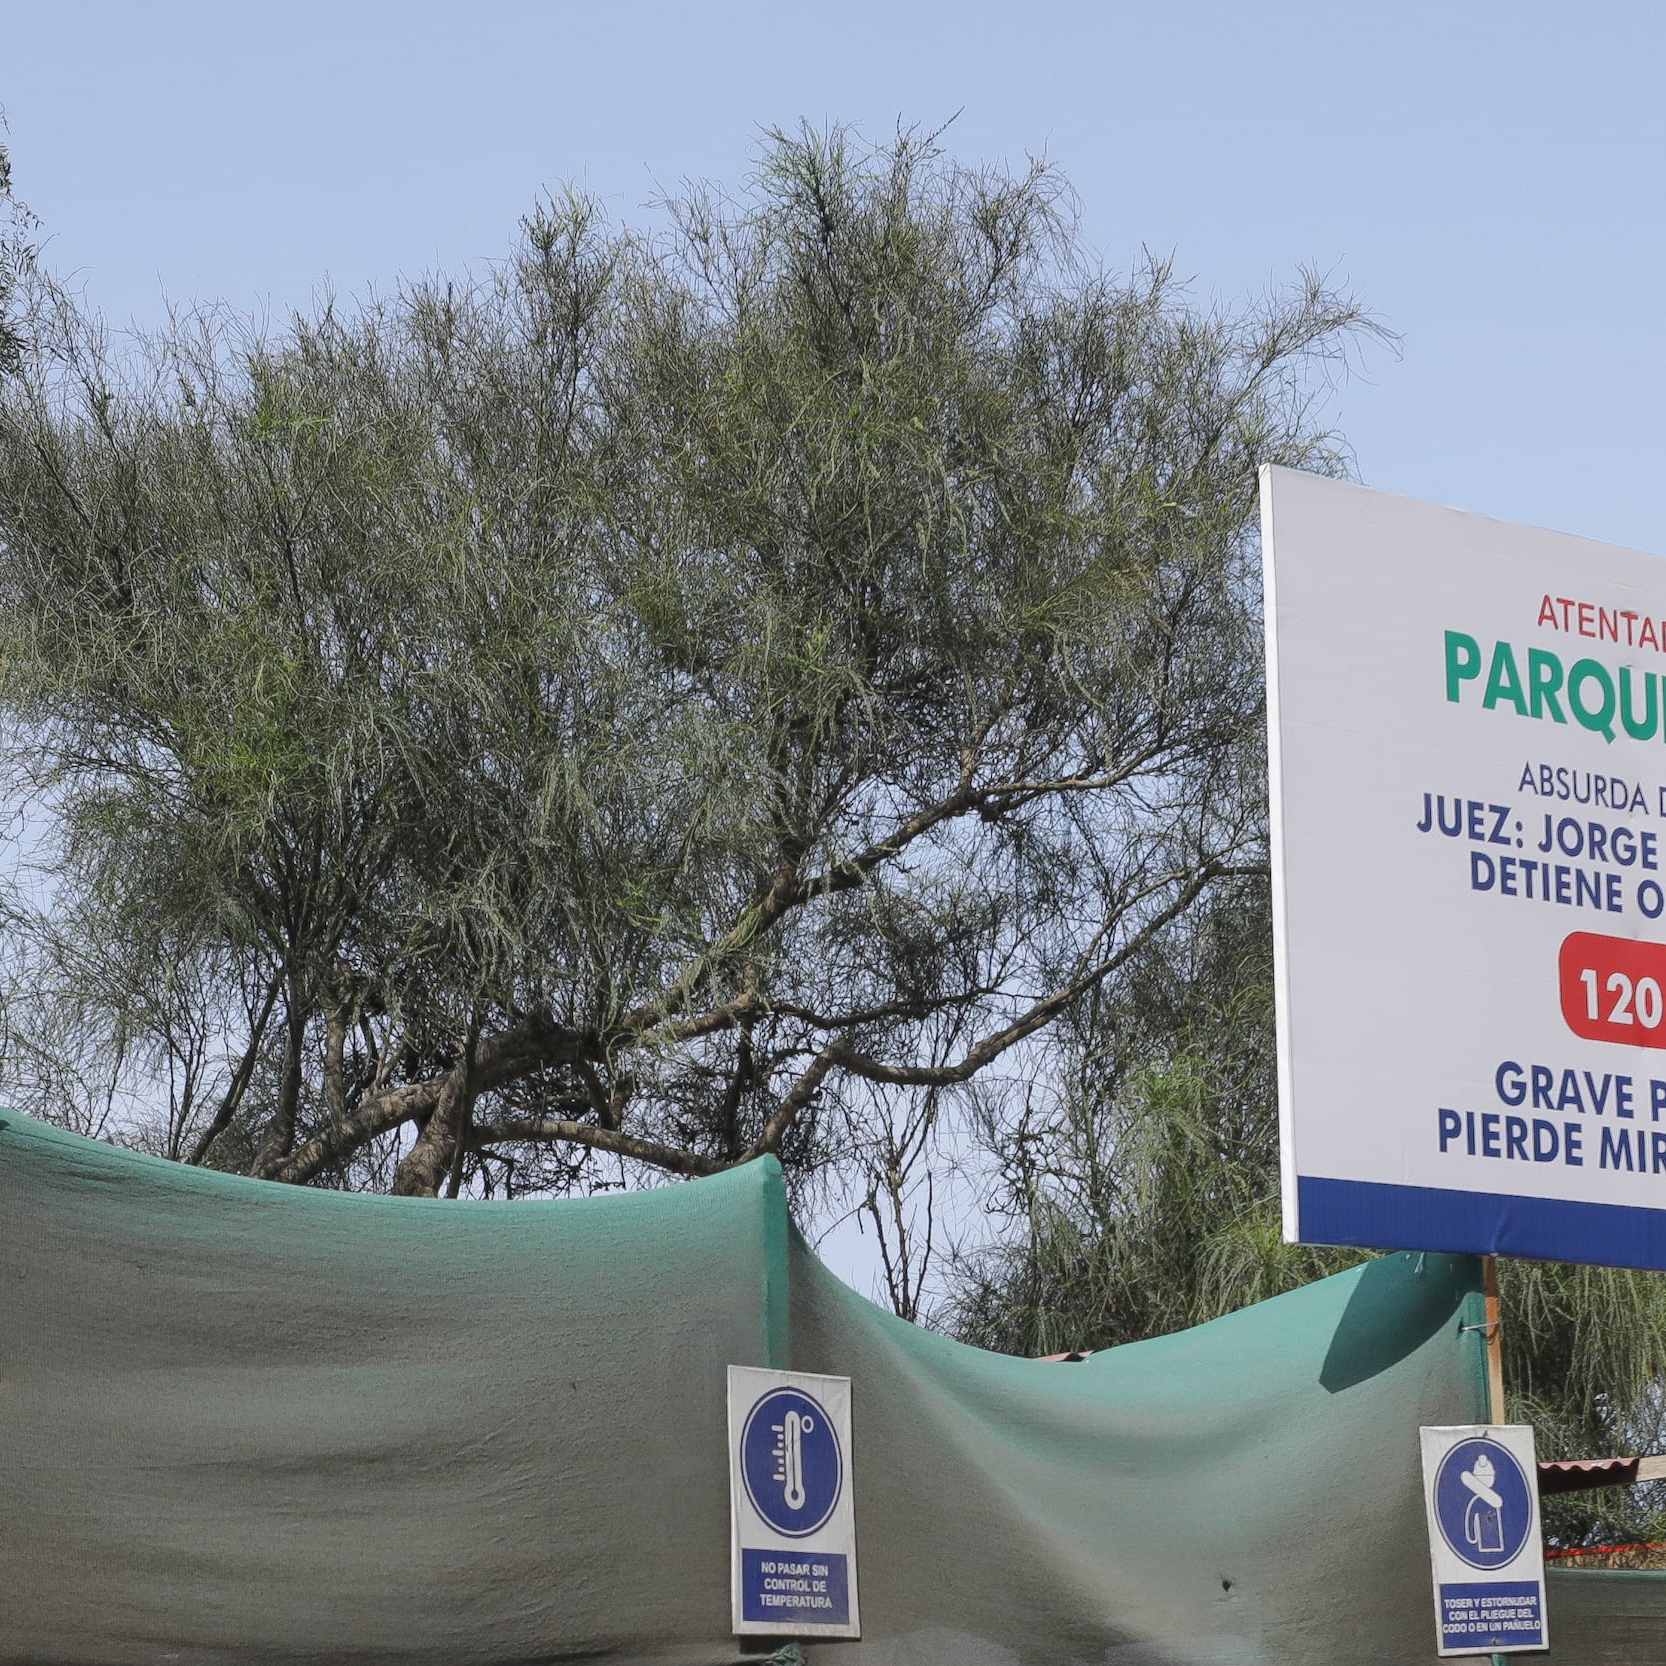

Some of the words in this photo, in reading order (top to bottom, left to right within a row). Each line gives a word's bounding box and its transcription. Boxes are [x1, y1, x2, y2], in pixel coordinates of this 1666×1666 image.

[1519, 762, 1649, 815] ABSURDA
[1417, 793, 1523, 849] JUEZ:
[1538, 814, 1658, 870] JORGE
[1471, 851, 1622, 913] DETIENE
[1580, 969, 1663, 1028] 120
[1496, 1061, 1634, 1119] GRAVE
[1438, 1108, 1583, 1166] PIERDE
[761, 1562, 776, 1574] NO
[778, 1563, 810, 1576] PASAR
[812, 1564, 828, 1576] SIN
[764, 1578, 811, 1592] CONTROL
[813, 1580, 827, 1592] DE
[760, 1594, 833, 1608] TEMPERATURA
[1444, 1598, 1473, 1609] TOSER
[1474, 1598, 1480, 1607] Y
[1481, 1596, 1537, 1607] ESTORNUDAR
[1448, 1610, 1468, 1621] CON
[1469, 1610, 1480, 1620] EL
[1480, 1609, 1516, 1619] PLIEGUE
[1517, 1608, 1534, 1618] DEL
[1442, 1623, 1467, 1633] CODO
[1468, 1622, 1475, 1632] O
[1476, 1622, 1488, 1632] EN
[1489, 1621, 1502, 1631] UN
[1502, 1619, 1541, 1631] PAÑUELO
